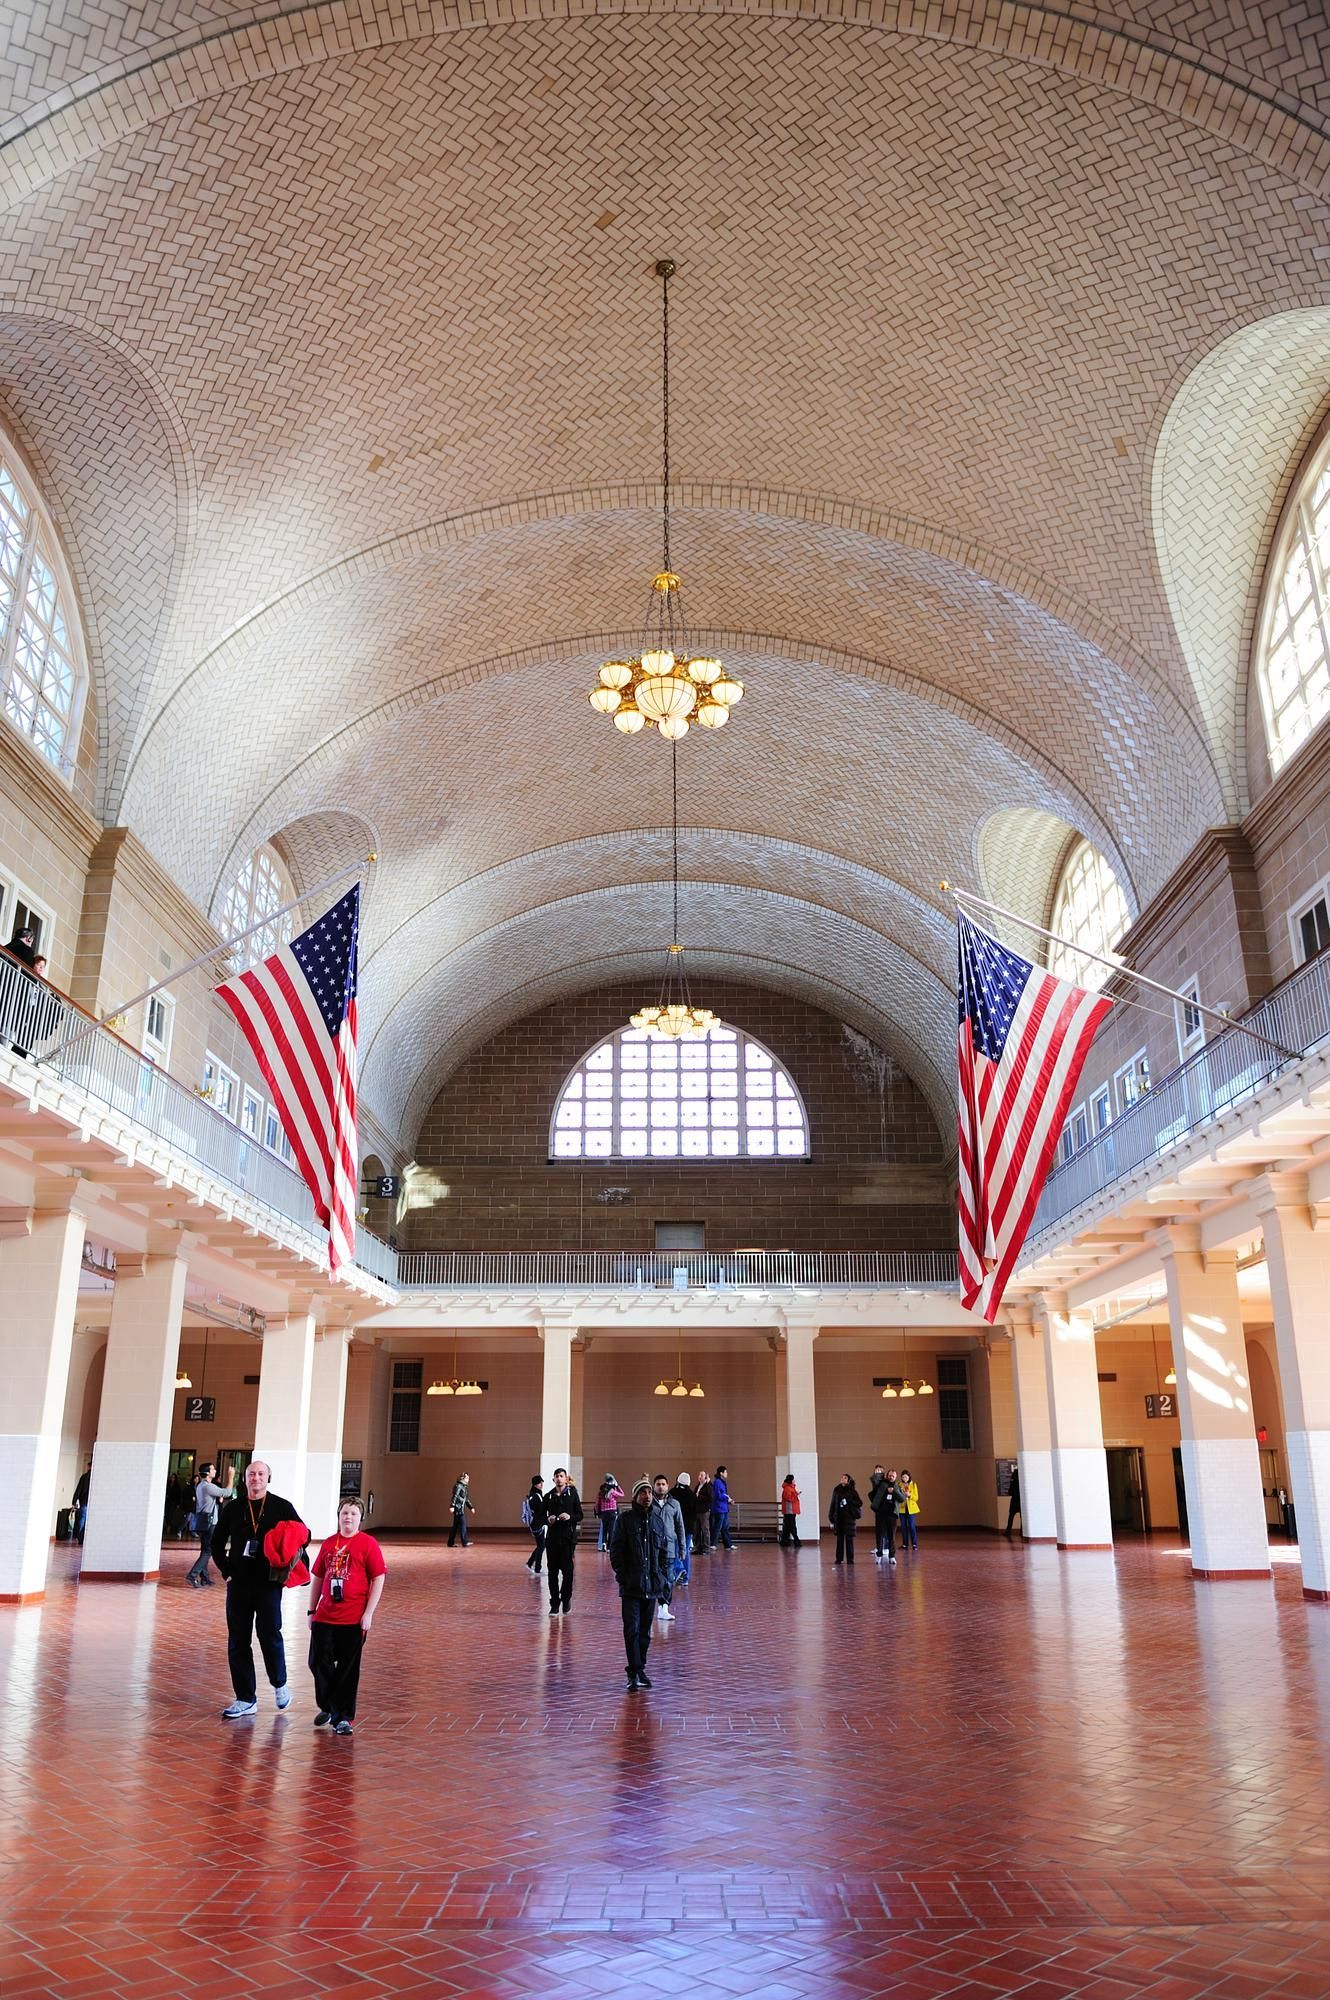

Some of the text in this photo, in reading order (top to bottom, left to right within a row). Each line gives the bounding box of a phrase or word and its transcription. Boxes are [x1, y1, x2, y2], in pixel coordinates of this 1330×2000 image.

[382, 1178, 392, 1192] 3
[192, 1398, 203, 1414] 2
[1160, 1395, 1171, 1410] 2
